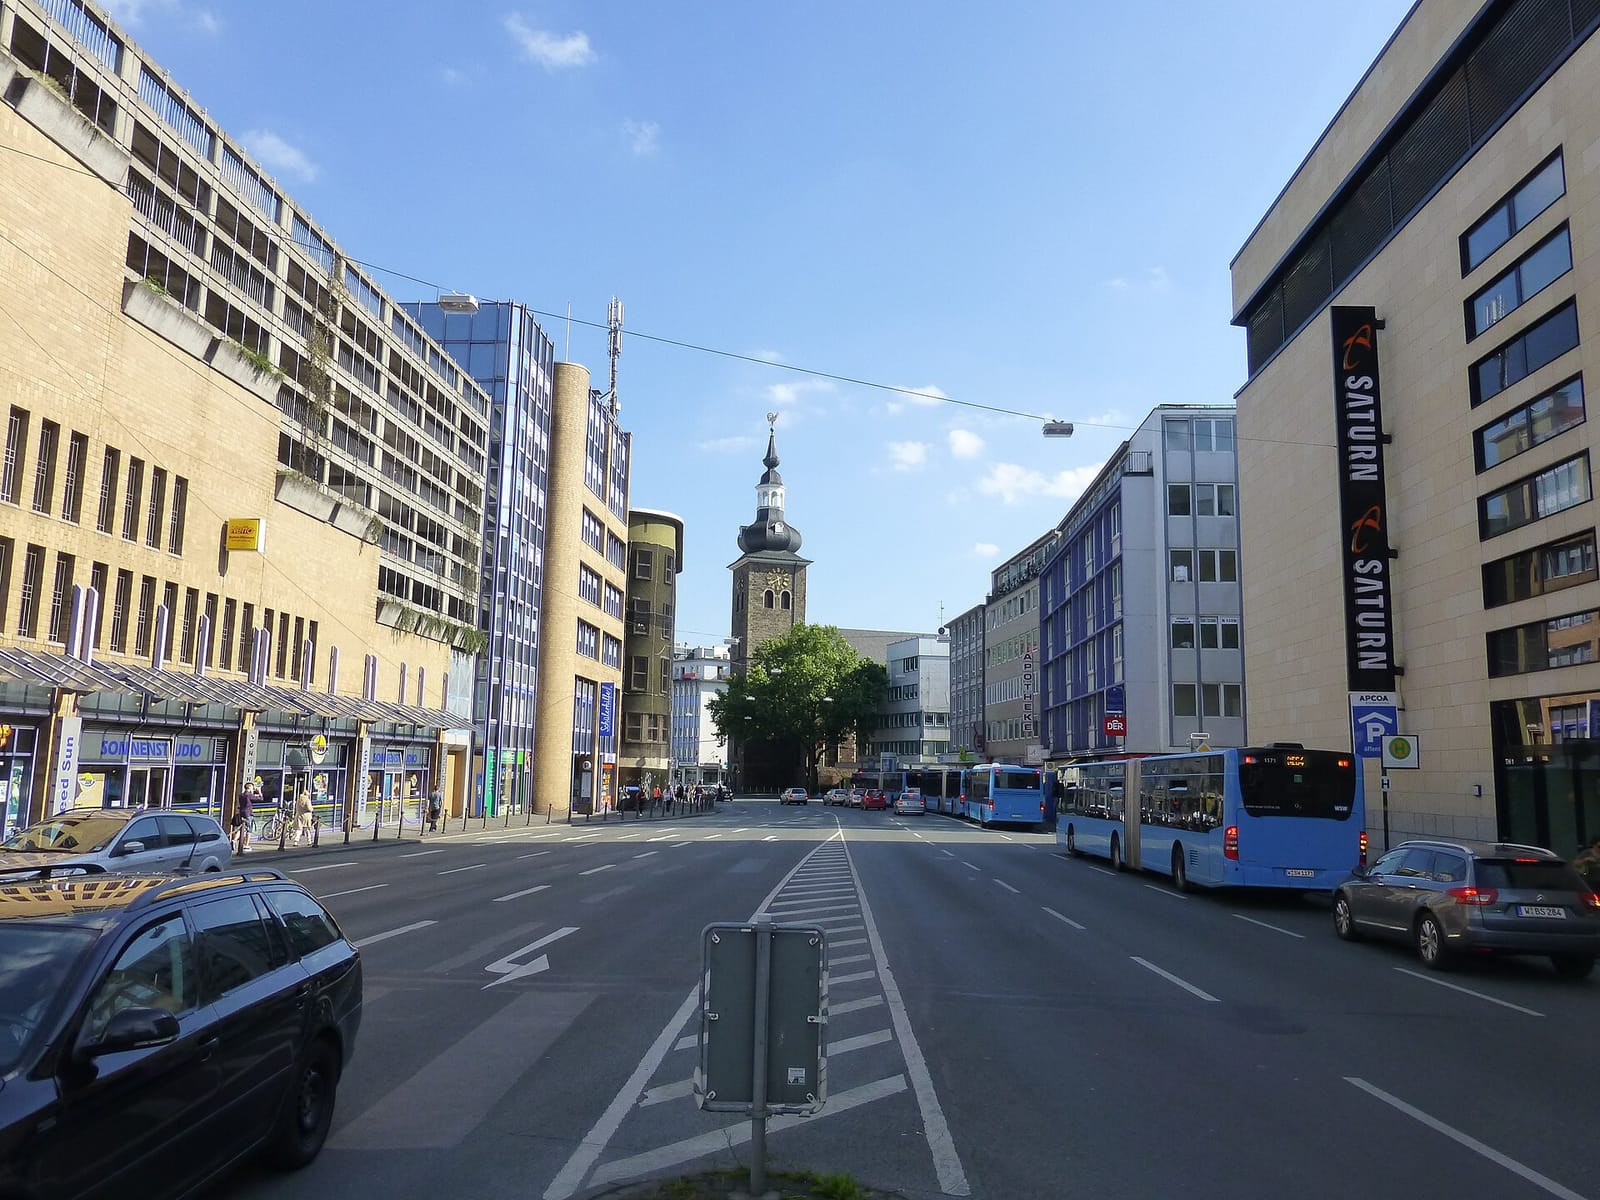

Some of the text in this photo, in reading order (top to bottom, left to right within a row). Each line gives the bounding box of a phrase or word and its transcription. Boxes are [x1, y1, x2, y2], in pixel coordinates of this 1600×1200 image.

[1345, 375, 1379, 481] SATURN
[1353, 559, 1388, 670] SATURN
[1023, 653, 1033, 731] APOTHEKE
[62, 736, 74, 772] Sun
[1366, 722, 1385, 743] P
[1381, 779, 1390, 789] H
